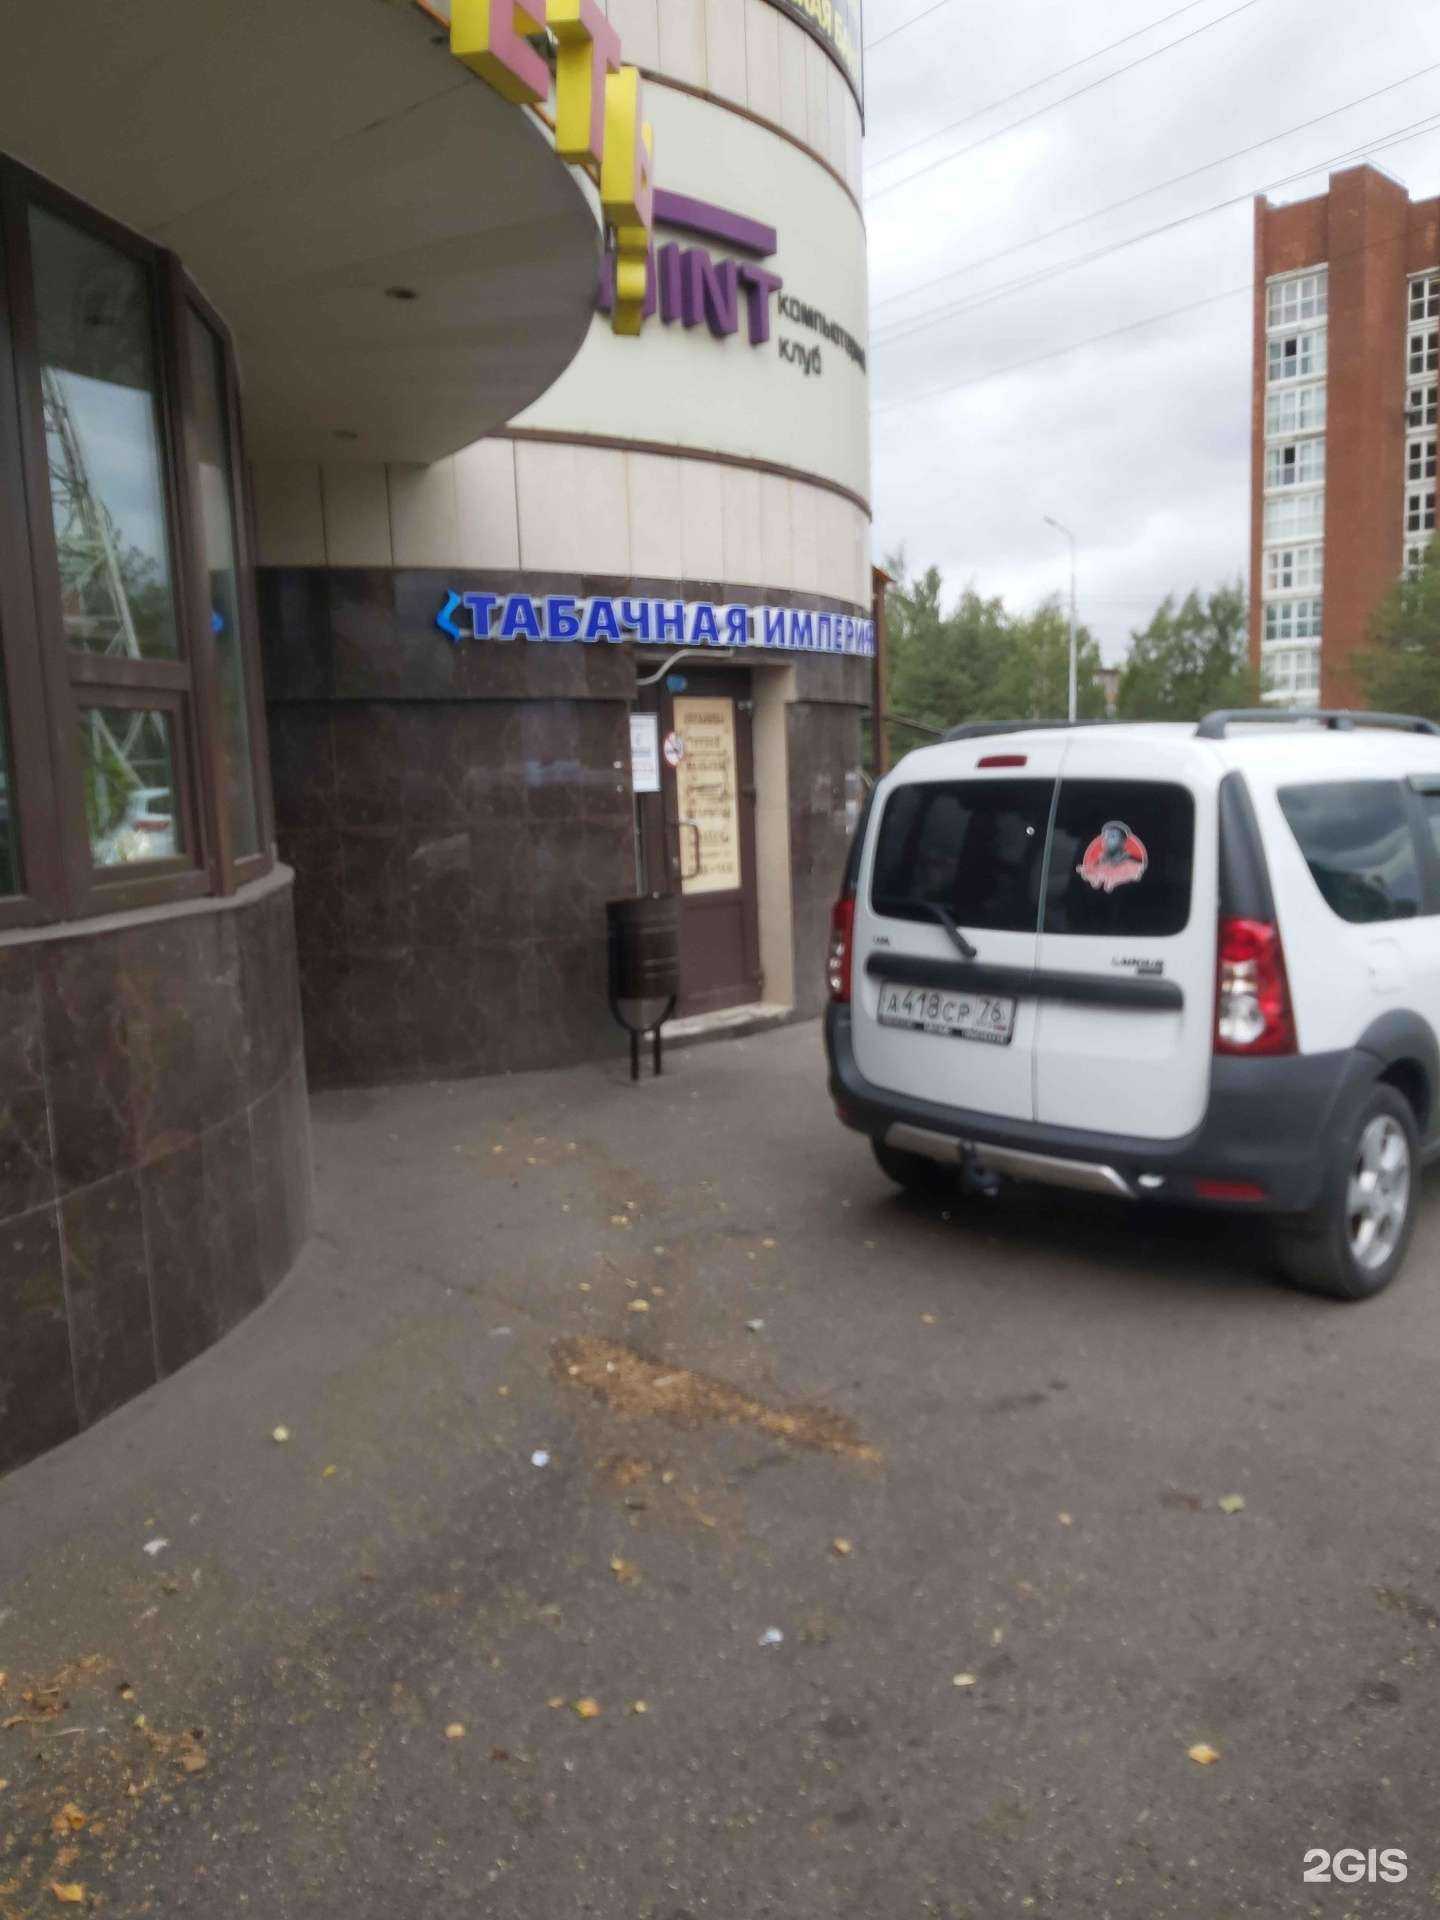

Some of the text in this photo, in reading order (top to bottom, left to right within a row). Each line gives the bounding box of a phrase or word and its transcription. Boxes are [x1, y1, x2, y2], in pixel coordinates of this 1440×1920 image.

[778, 337, 822, 376] клуб
[461, 591, 875, 657] ТАБАЧНАЯ ИМПЕРИЯ
